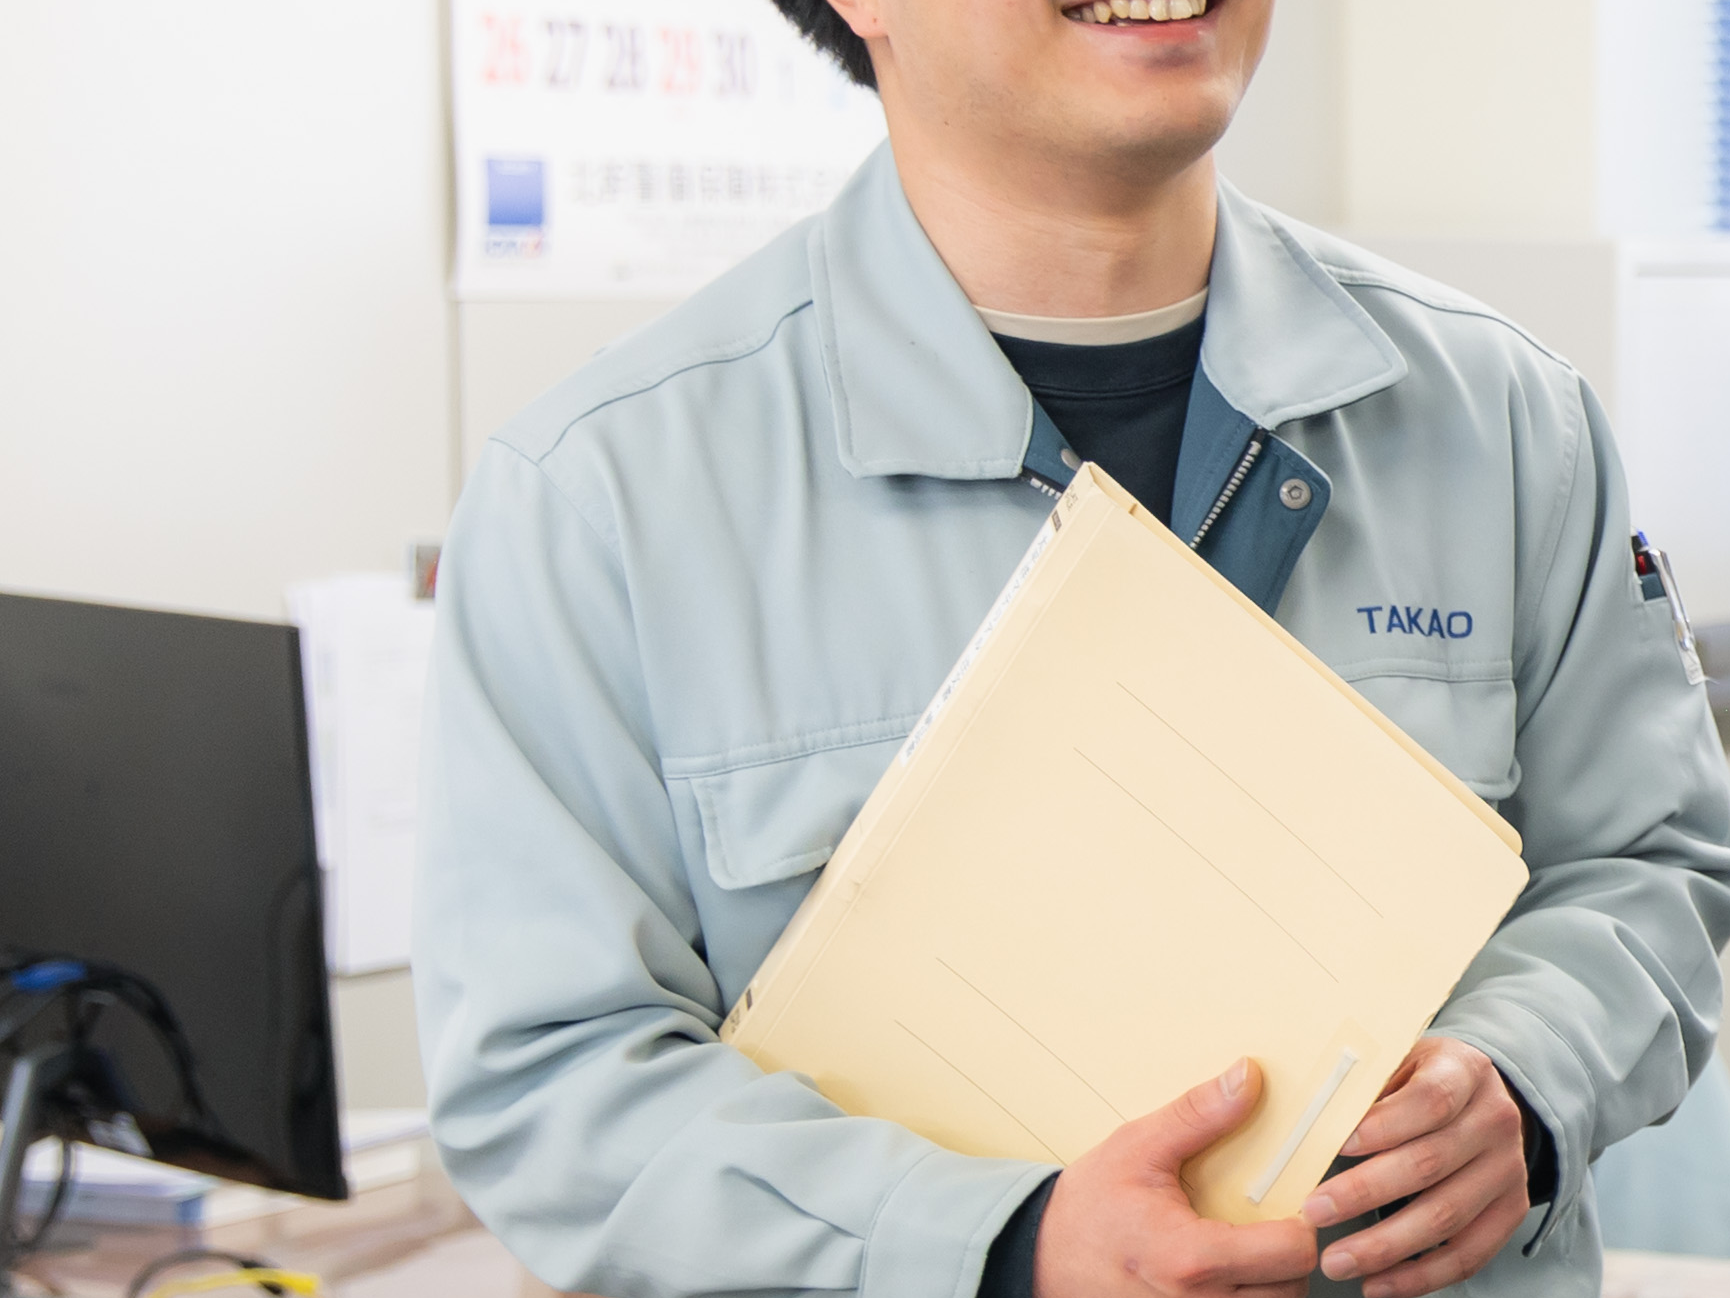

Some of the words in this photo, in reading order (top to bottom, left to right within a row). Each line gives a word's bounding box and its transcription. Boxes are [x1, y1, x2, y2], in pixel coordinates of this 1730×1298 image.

[480, 12, 531, 86] 26
[542, 19, 589, 88] 27
[713, 31, 759, 98] 30
[1356, 605, 1473, 639] TAKAO
